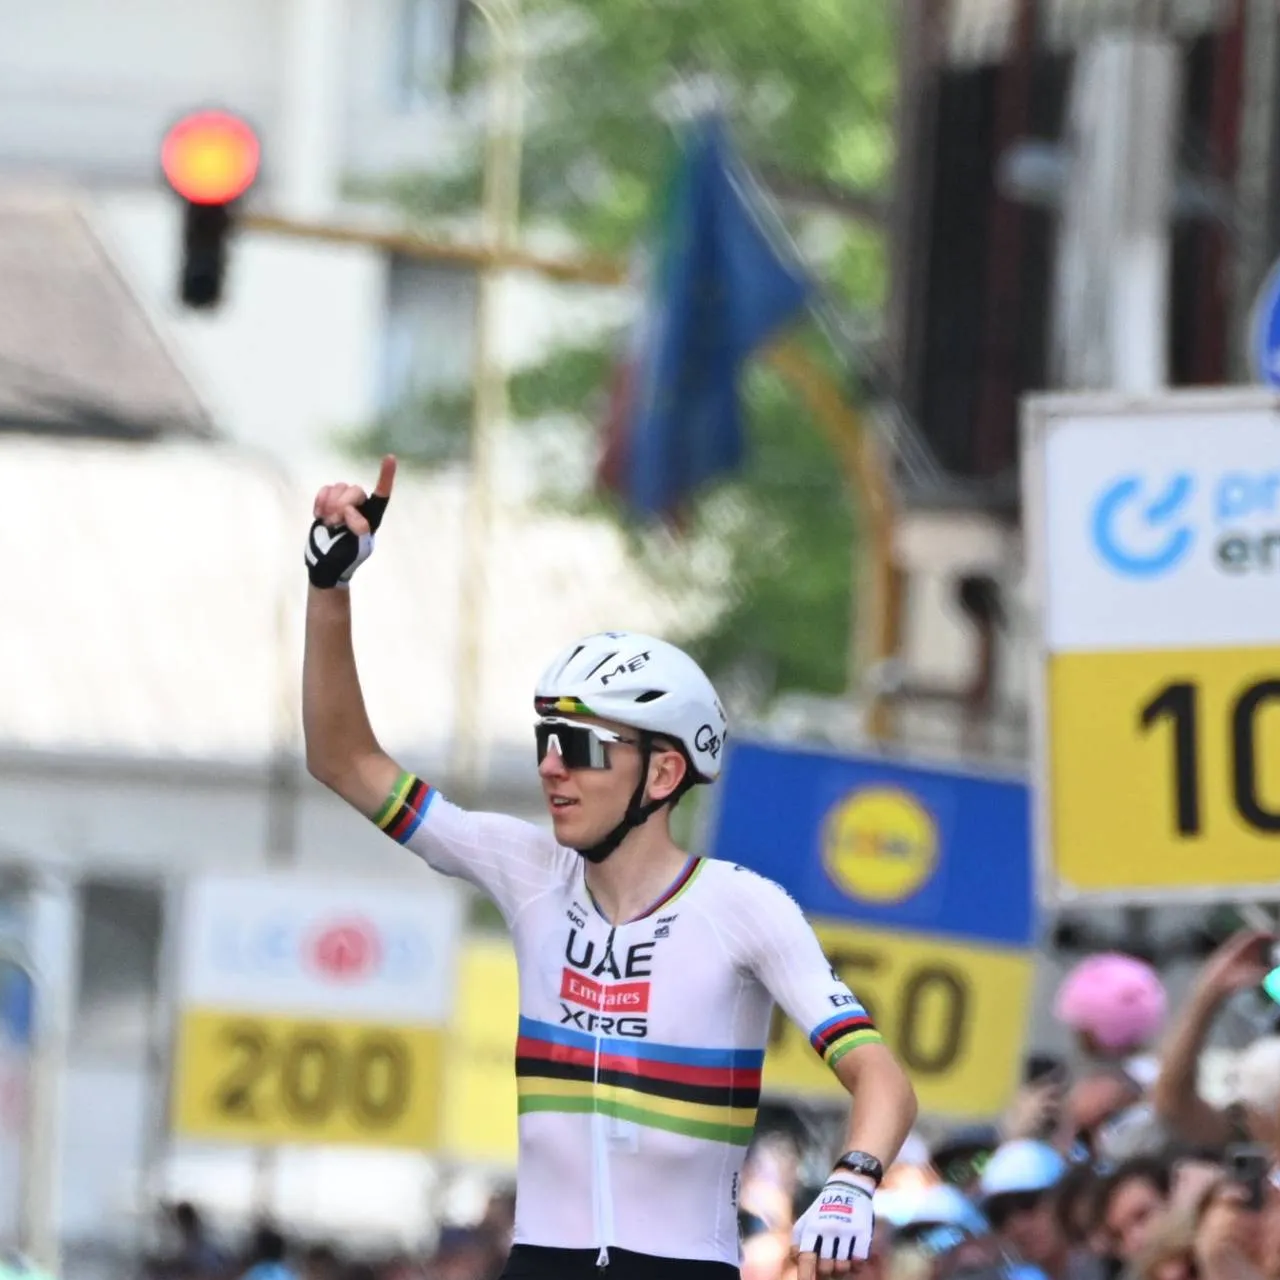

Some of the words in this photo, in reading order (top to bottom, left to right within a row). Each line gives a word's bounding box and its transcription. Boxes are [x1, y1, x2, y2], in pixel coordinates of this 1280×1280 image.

[600, 651, 651, 685] MET
[565, 926, 657, 980] UAE
[560, 1002, 648, 1038] XRG
[214, 1021, 416, 1134] 200
